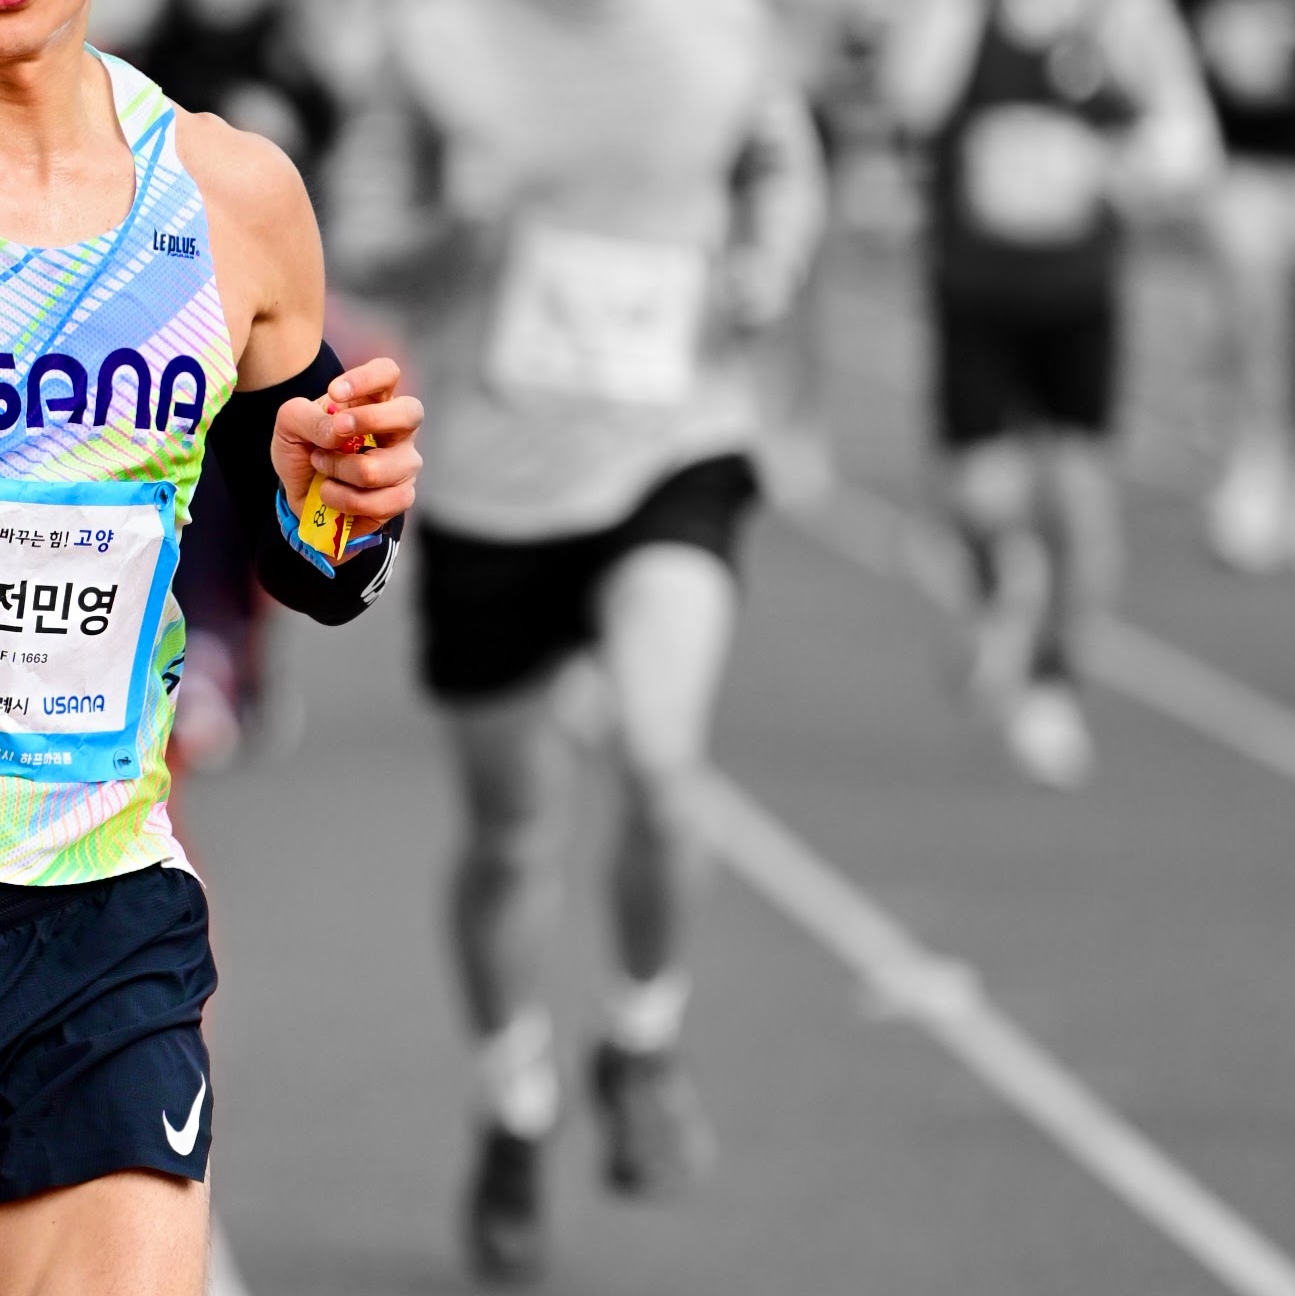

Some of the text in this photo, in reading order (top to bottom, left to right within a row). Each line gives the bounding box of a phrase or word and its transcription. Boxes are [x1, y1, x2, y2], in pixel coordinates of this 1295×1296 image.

[0, 527, 45, 548] 바꾸는
[49, 530, 69, 548] 힘!
[73, 529, 114, 553] 고양
[20, 653, 48, 664] 1663
[43, 694, 105, 715] USANA
